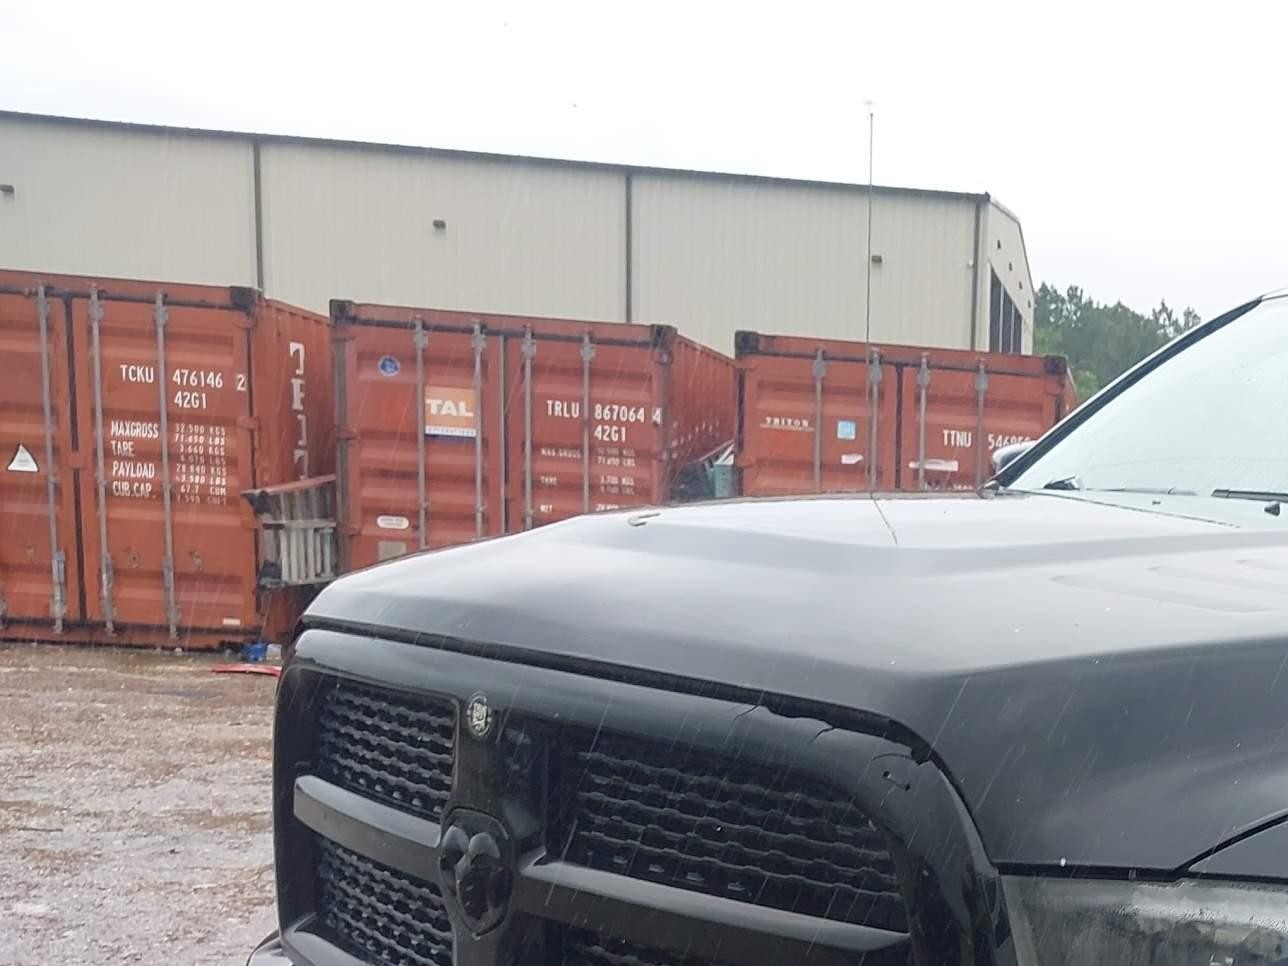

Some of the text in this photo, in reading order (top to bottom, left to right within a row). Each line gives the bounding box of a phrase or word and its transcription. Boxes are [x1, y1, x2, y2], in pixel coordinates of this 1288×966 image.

[120, 364, 248, 391] TCKU 476146 2
[174, 391, 207, 409] 42G1
[425, 399, 474, 417] TAL
[547, 399, 580, 418] TRLU
[594, 403, 645, 423] 867064
[111, 420, 159, 439] MAXGROSS
[594, 425, 626, 443] 42G1
[942, 429, 972, 448] TTNU
[110, 440, 135, 457] TARE
[112, 460, 155, 479] PAYLOAD
